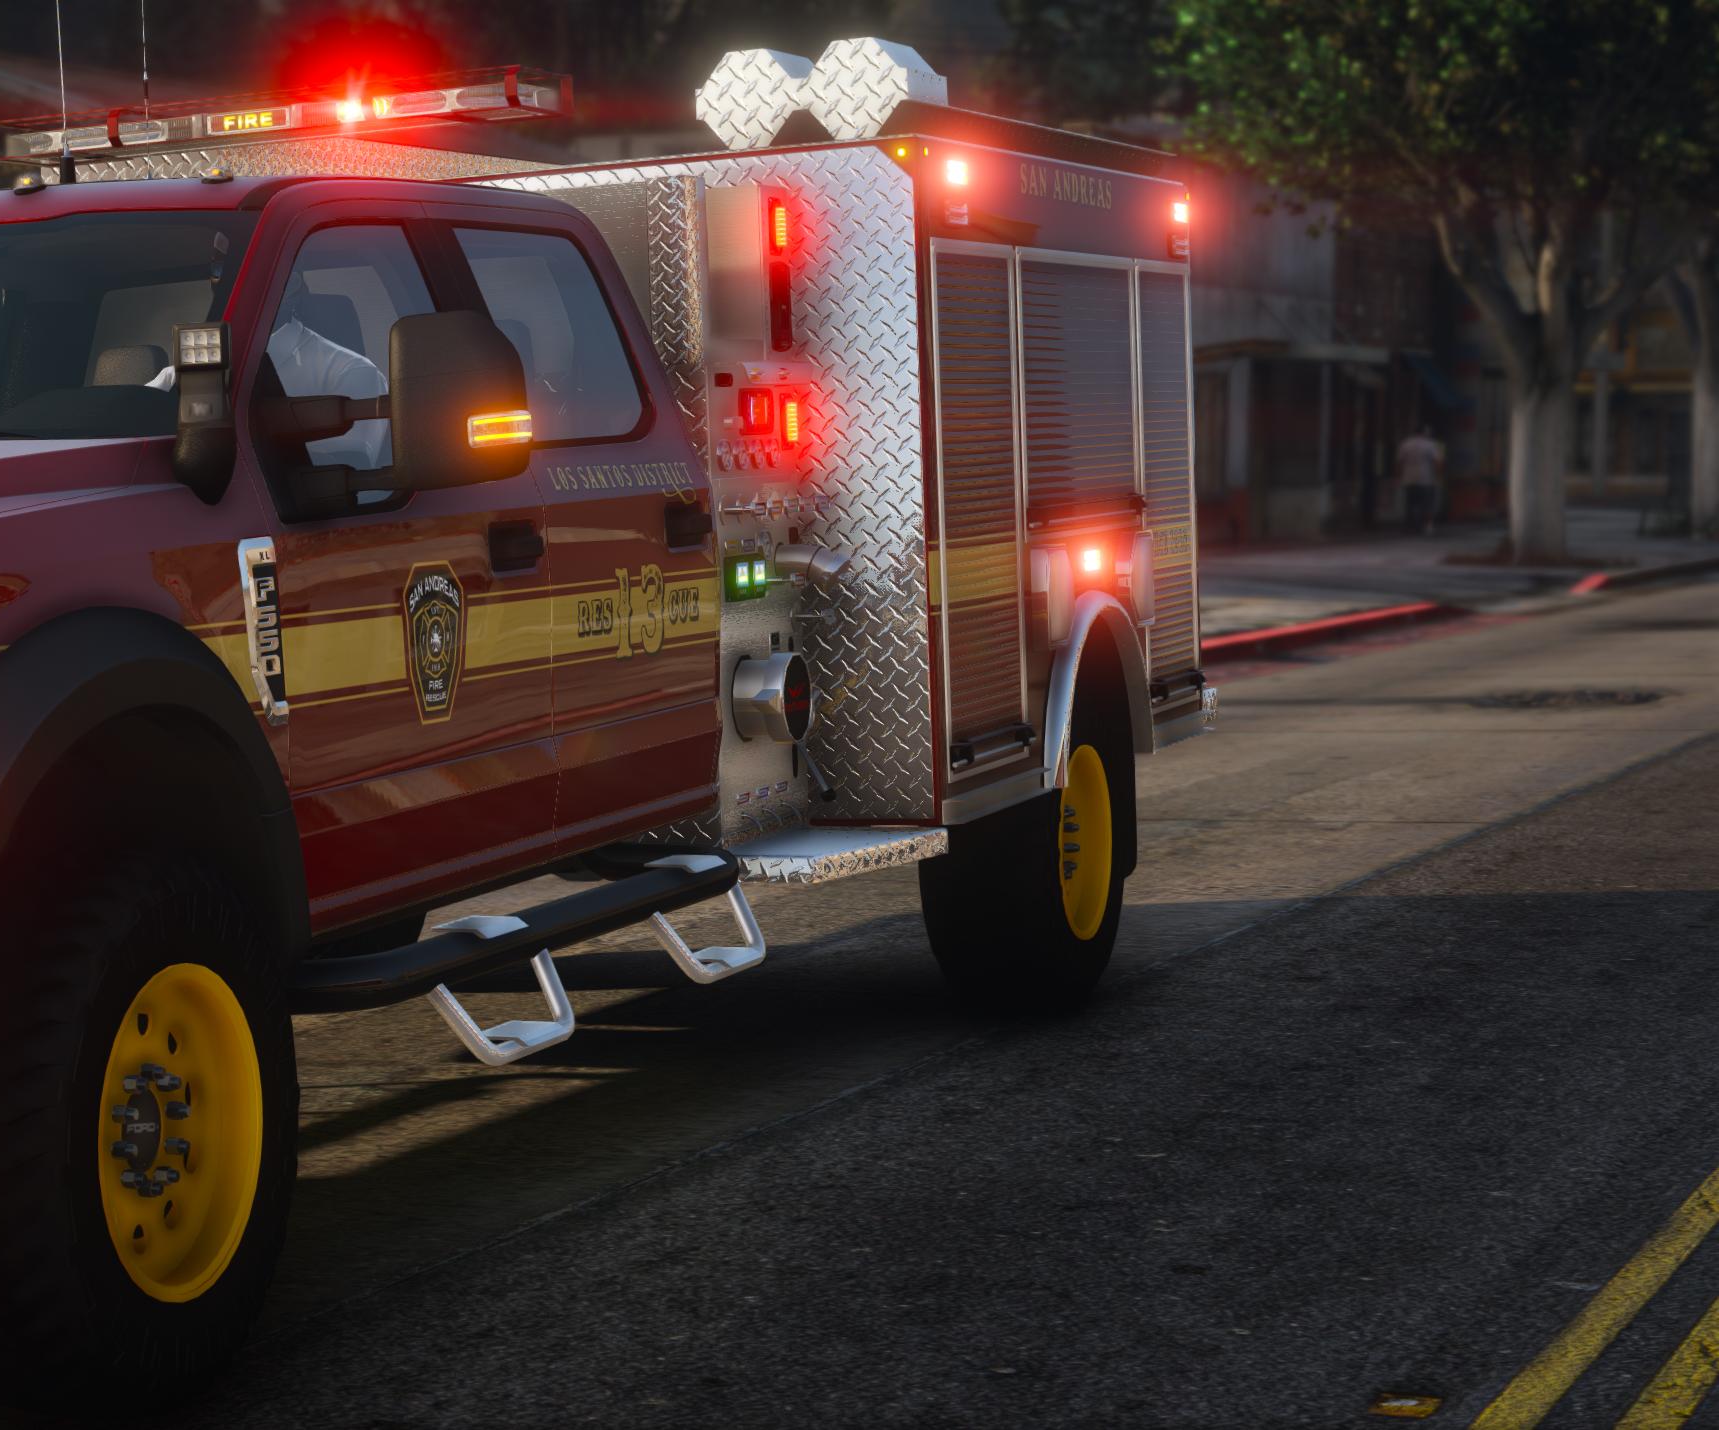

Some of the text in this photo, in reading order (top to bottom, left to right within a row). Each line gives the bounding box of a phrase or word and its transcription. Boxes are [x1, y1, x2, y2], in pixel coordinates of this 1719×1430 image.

[223, 111, 273, 131] FIRE
[1020, 162, 1112, 209] SAN ANDREAS
[547, 462, 697, 501] LOS SANTOS DISTRICT
[410, 575, 460, 613] SAN ANDREAS
[577, 563, 700, 660] RES 13 CUE
[425, 690, 447, 702] RESCUE
[428, 679, 444, 690] FIRE
[127, 1122, 155, 1134] FORD
